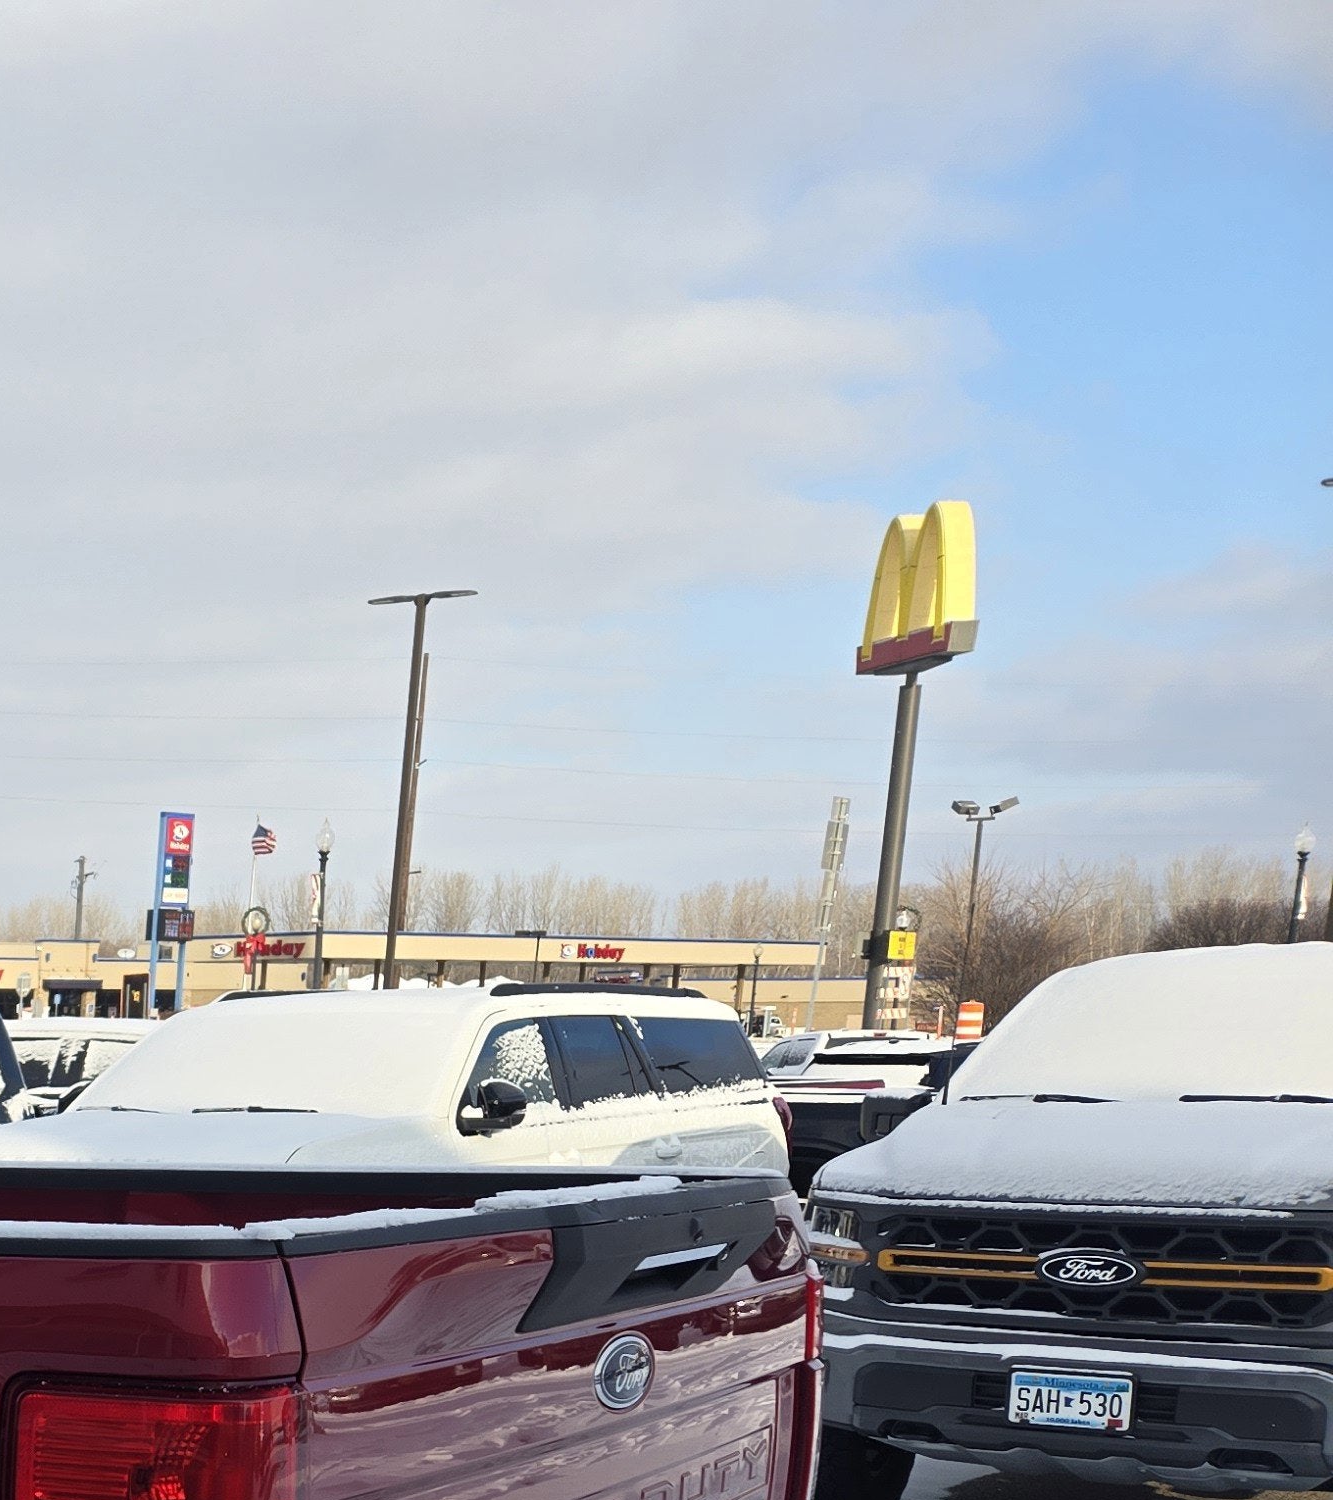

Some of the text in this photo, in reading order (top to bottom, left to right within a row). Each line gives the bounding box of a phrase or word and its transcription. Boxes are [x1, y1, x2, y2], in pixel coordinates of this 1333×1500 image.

[577, 943, 626, 962] Holiday
[1059, 1259, 1119, 1281] Ford
[615, 1353, 650, 1393] Ford
[1044, 1377, 1099, 1390] Minnesota
[1016, 1387, 1123, 1418] SAH 530
